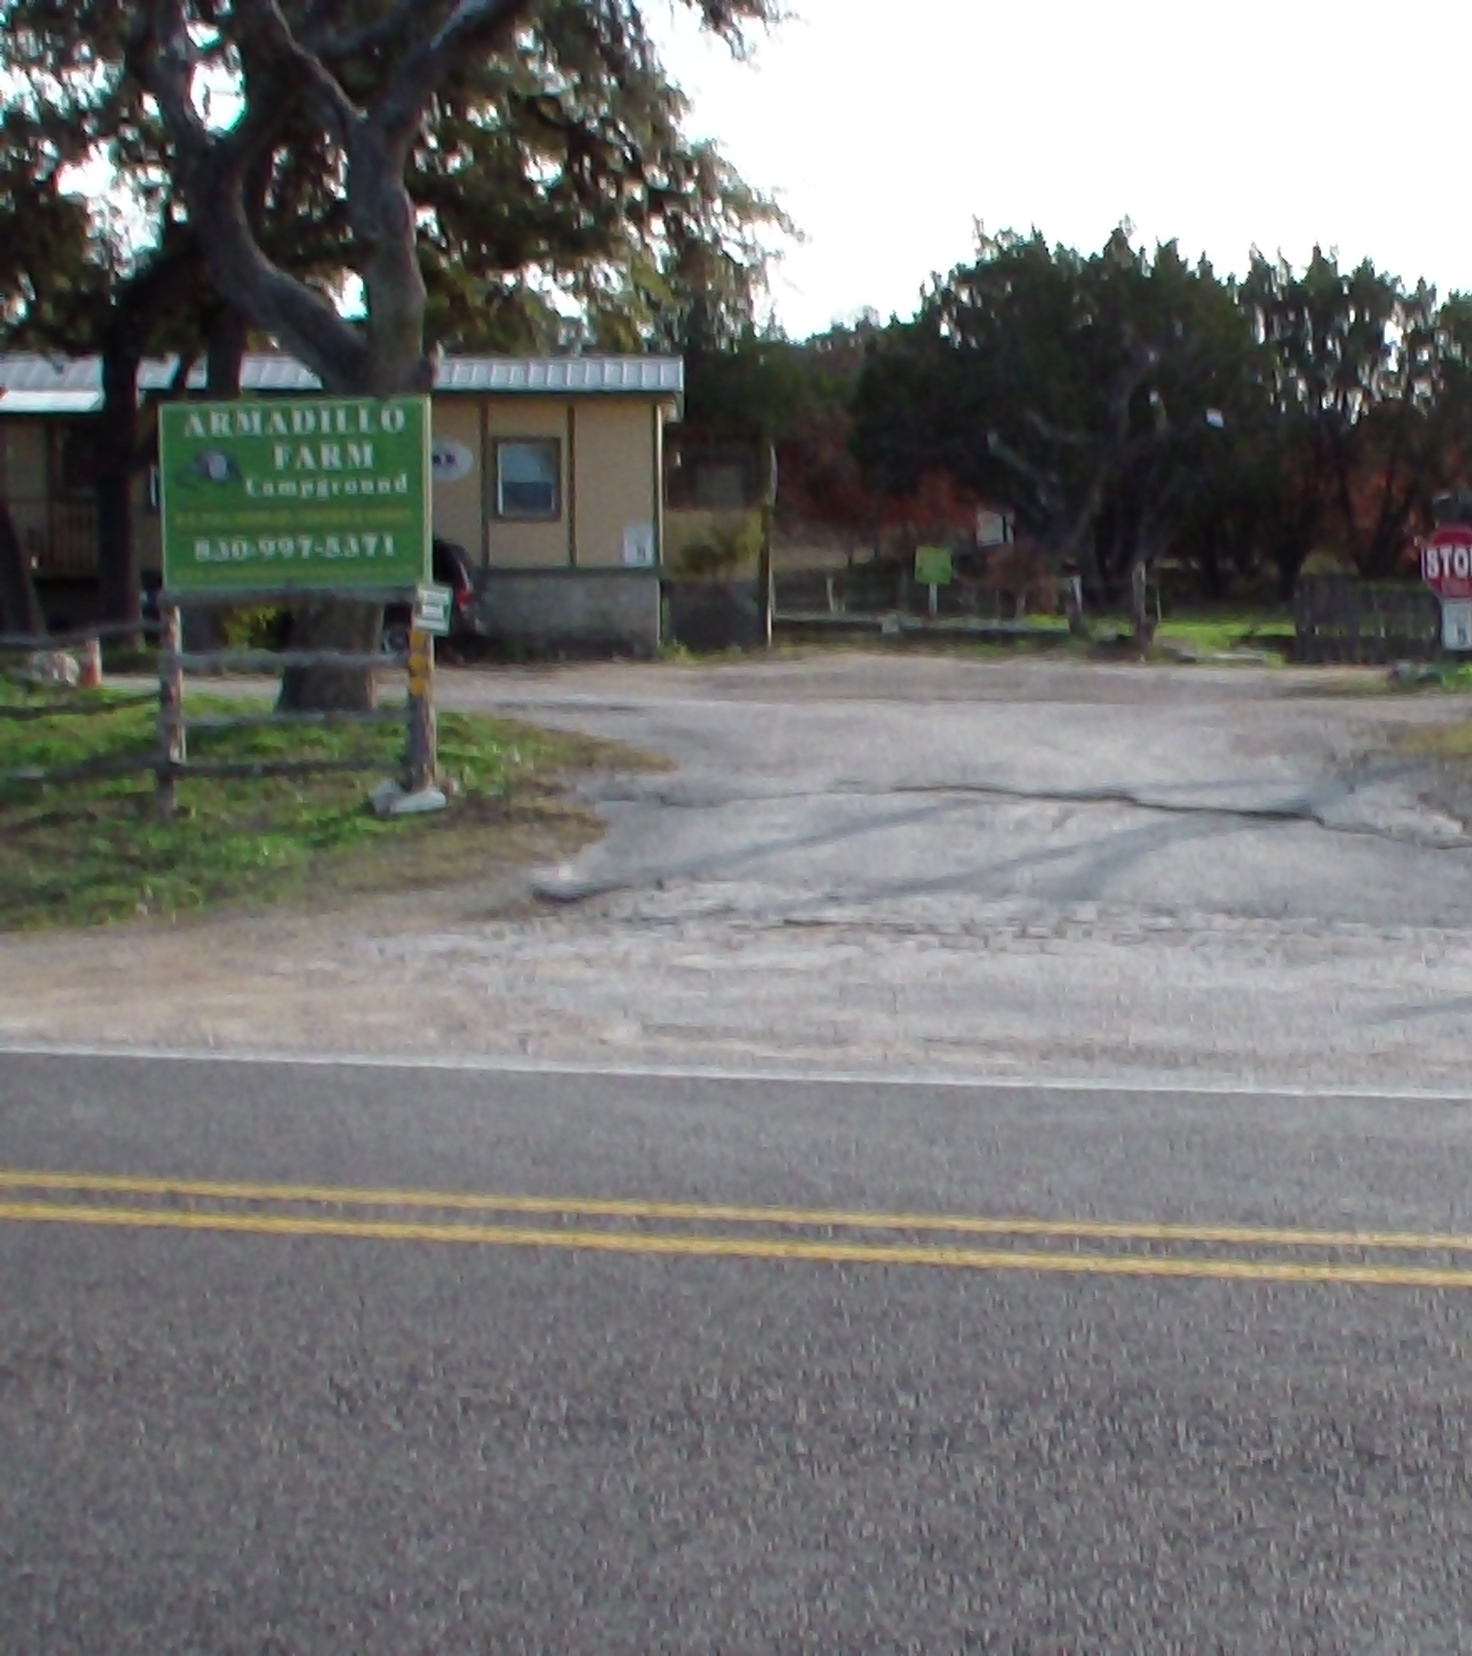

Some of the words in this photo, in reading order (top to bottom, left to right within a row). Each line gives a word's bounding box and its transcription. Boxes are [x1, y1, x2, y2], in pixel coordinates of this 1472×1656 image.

[184, 405, 405, 437] ARMADILLO
[273, 442, 374, 471] FARM
[245, 474, 408, 499] Campground
